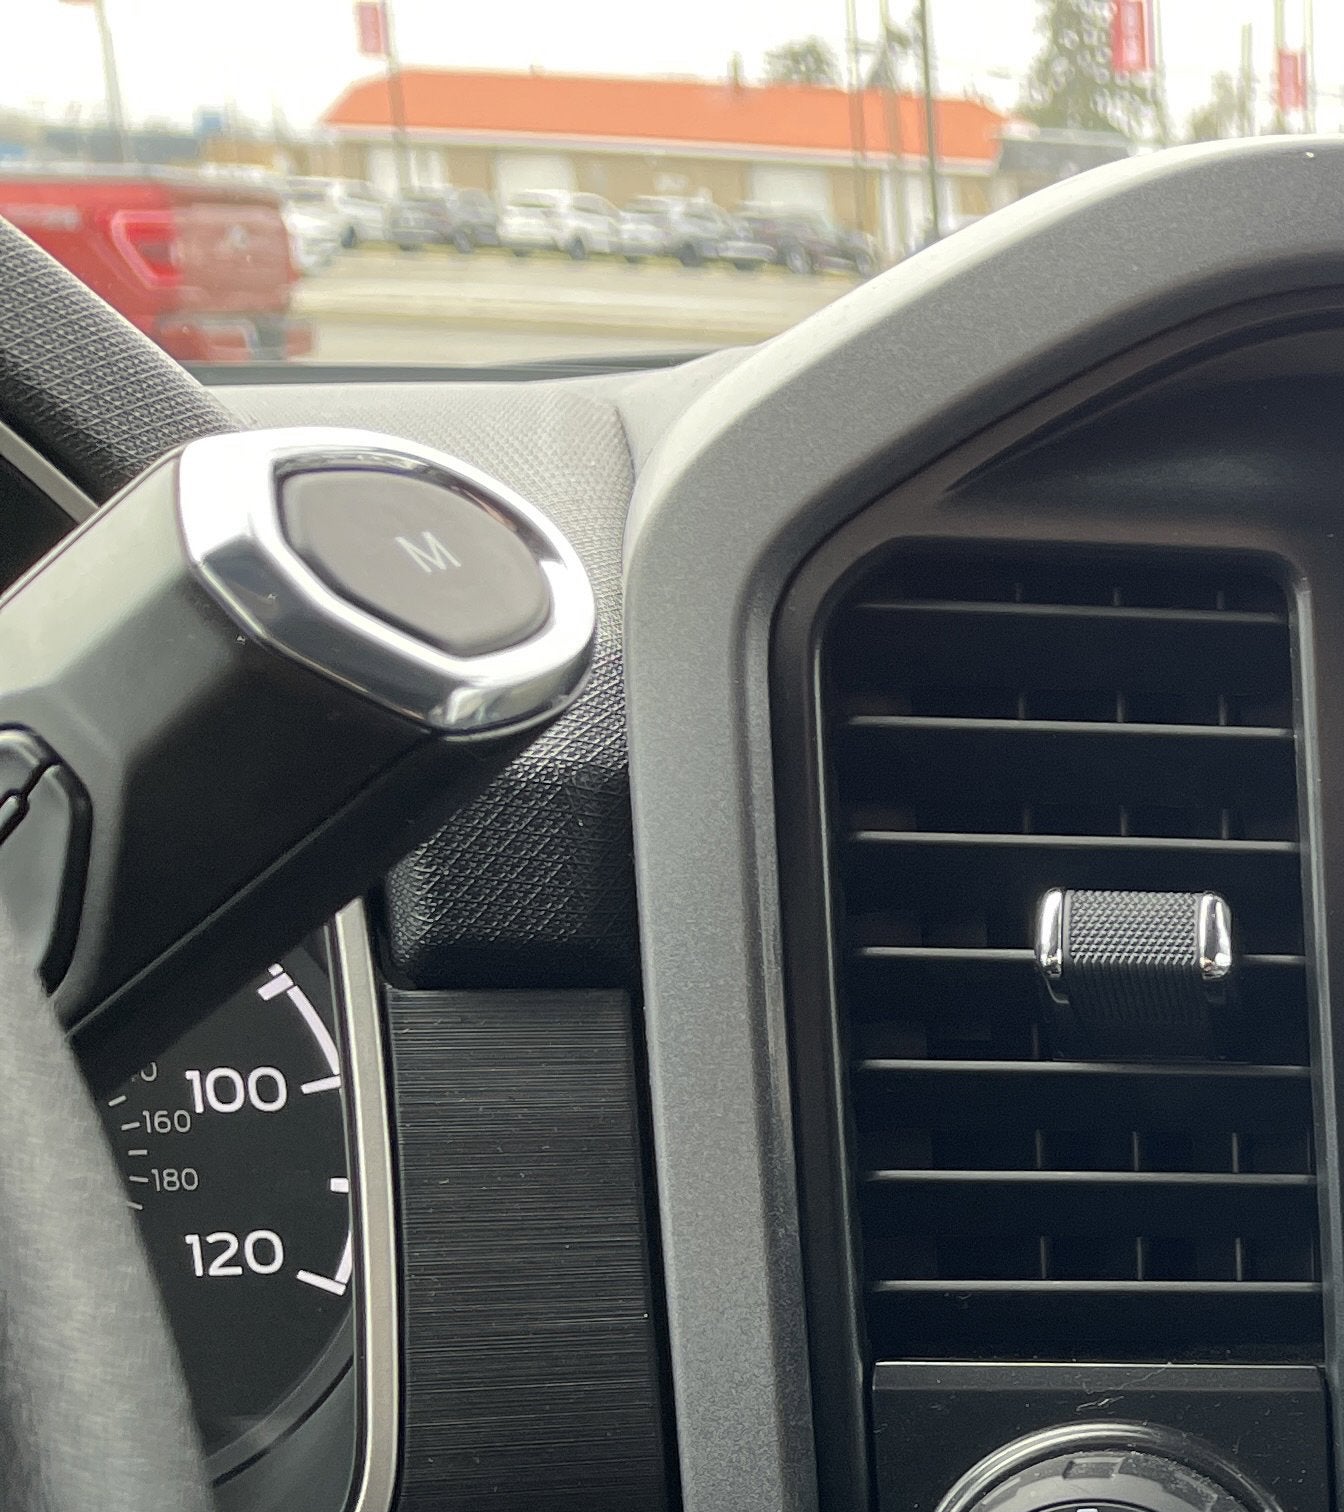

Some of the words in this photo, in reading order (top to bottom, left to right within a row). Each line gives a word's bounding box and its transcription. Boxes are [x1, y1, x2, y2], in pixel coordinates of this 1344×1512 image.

[394, 531, 462, 575] M
[185, 1065, 288, 1114] 100
[142, 1109, 192, 1134] 160
[150, 1167, 199, 1192] 180
[184, 1229, 284, 1277] 120
